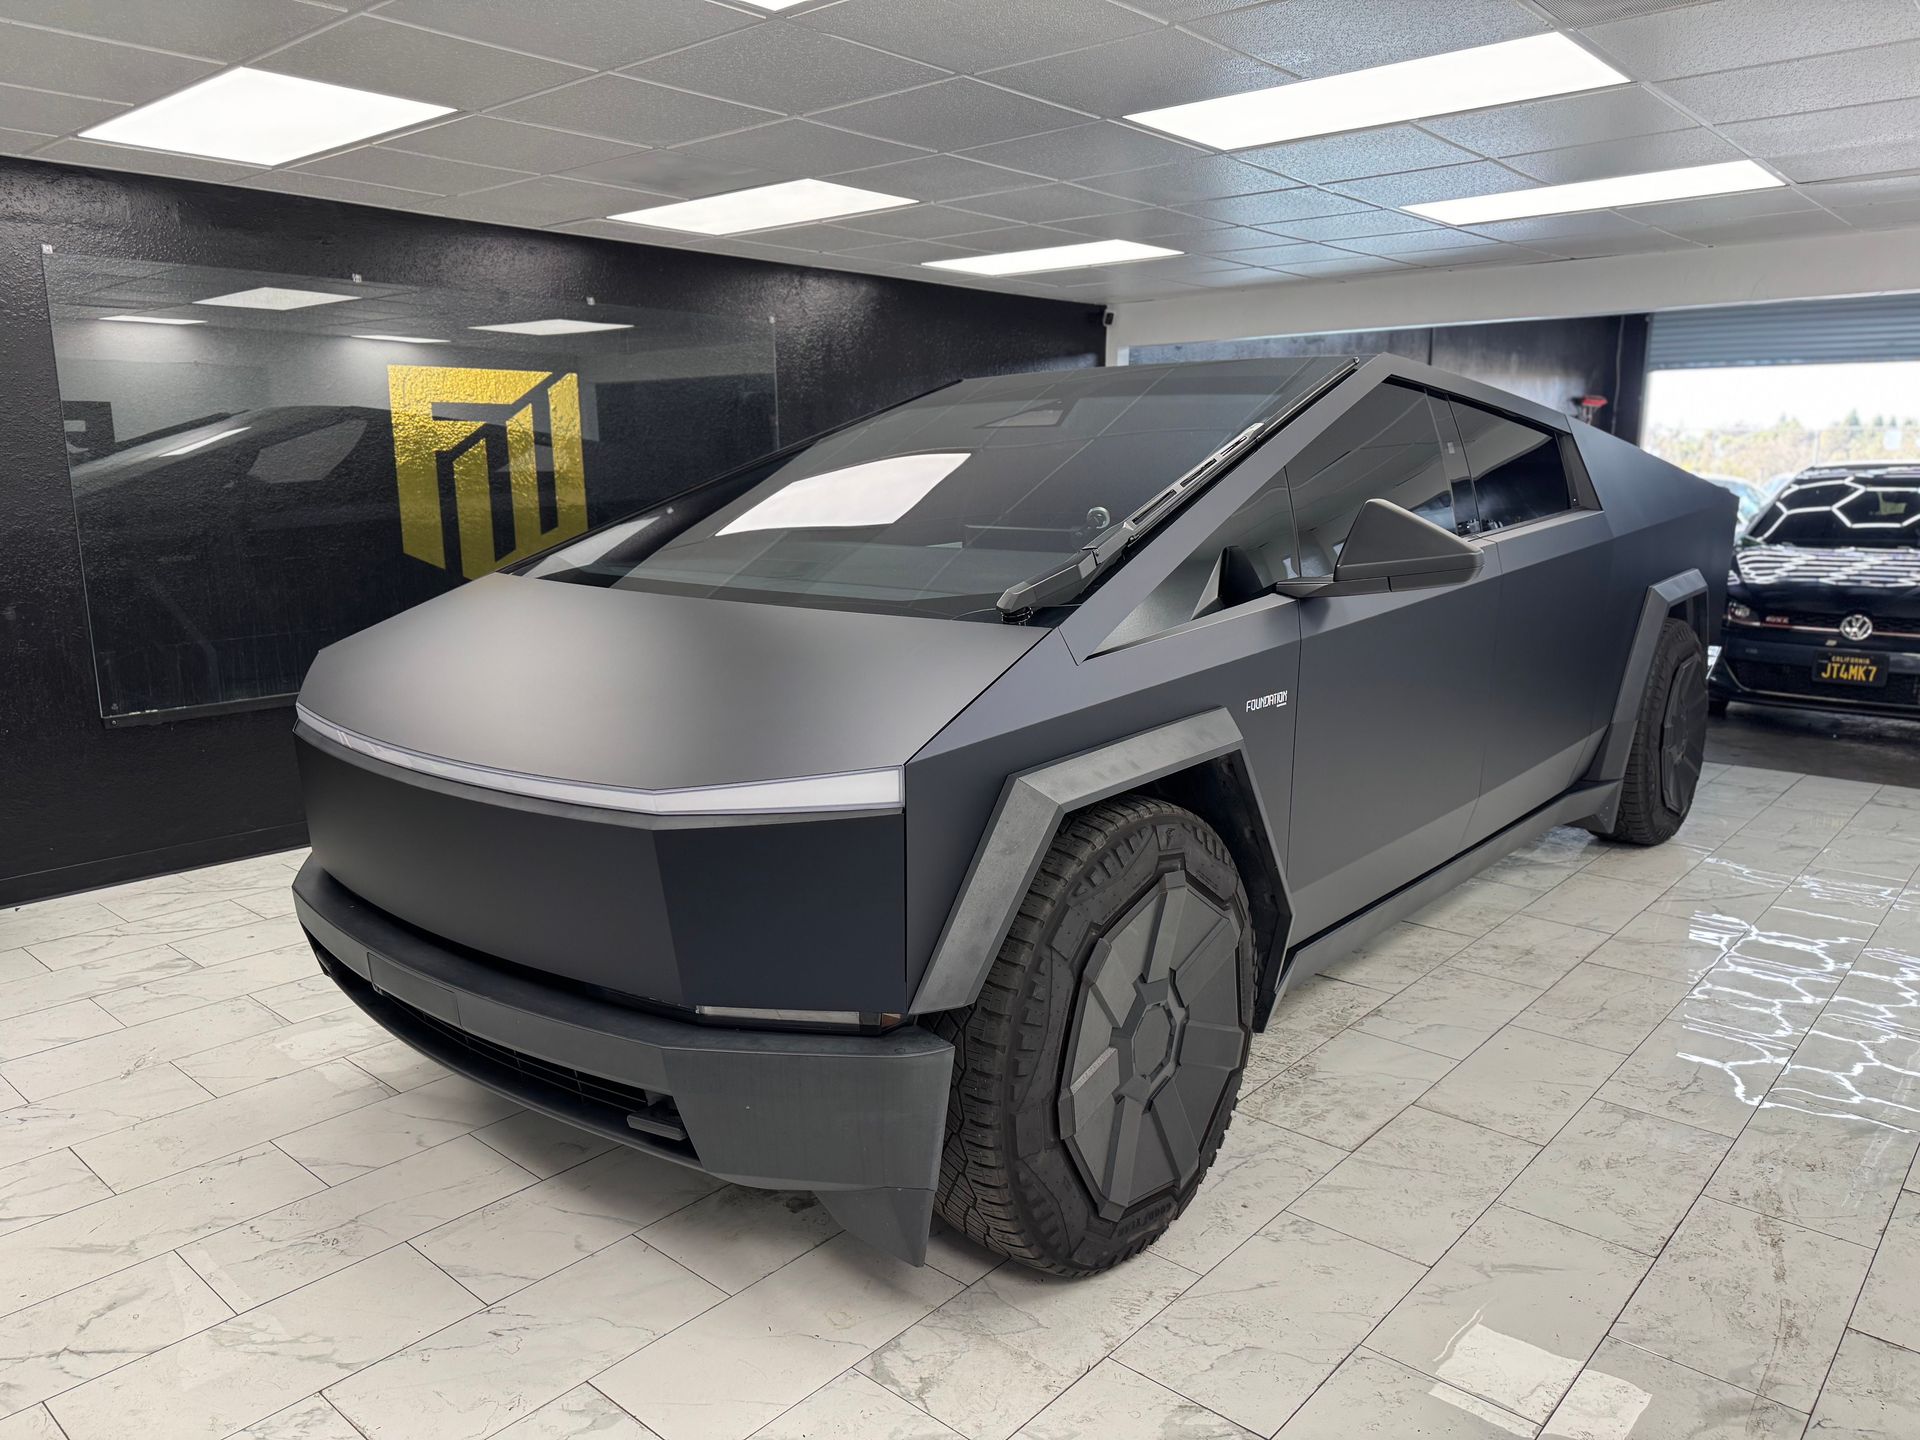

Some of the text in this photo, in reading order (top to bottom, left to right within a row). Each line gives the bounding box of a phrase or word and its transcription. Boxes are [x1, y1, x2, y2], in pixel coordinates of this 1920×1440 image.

[1831, 655, 1870, 665] CALIFORNIA
[1821, 662, 1877, 682] JT4MK7
[1245, 690, 1288, 713] FOUNDATION
